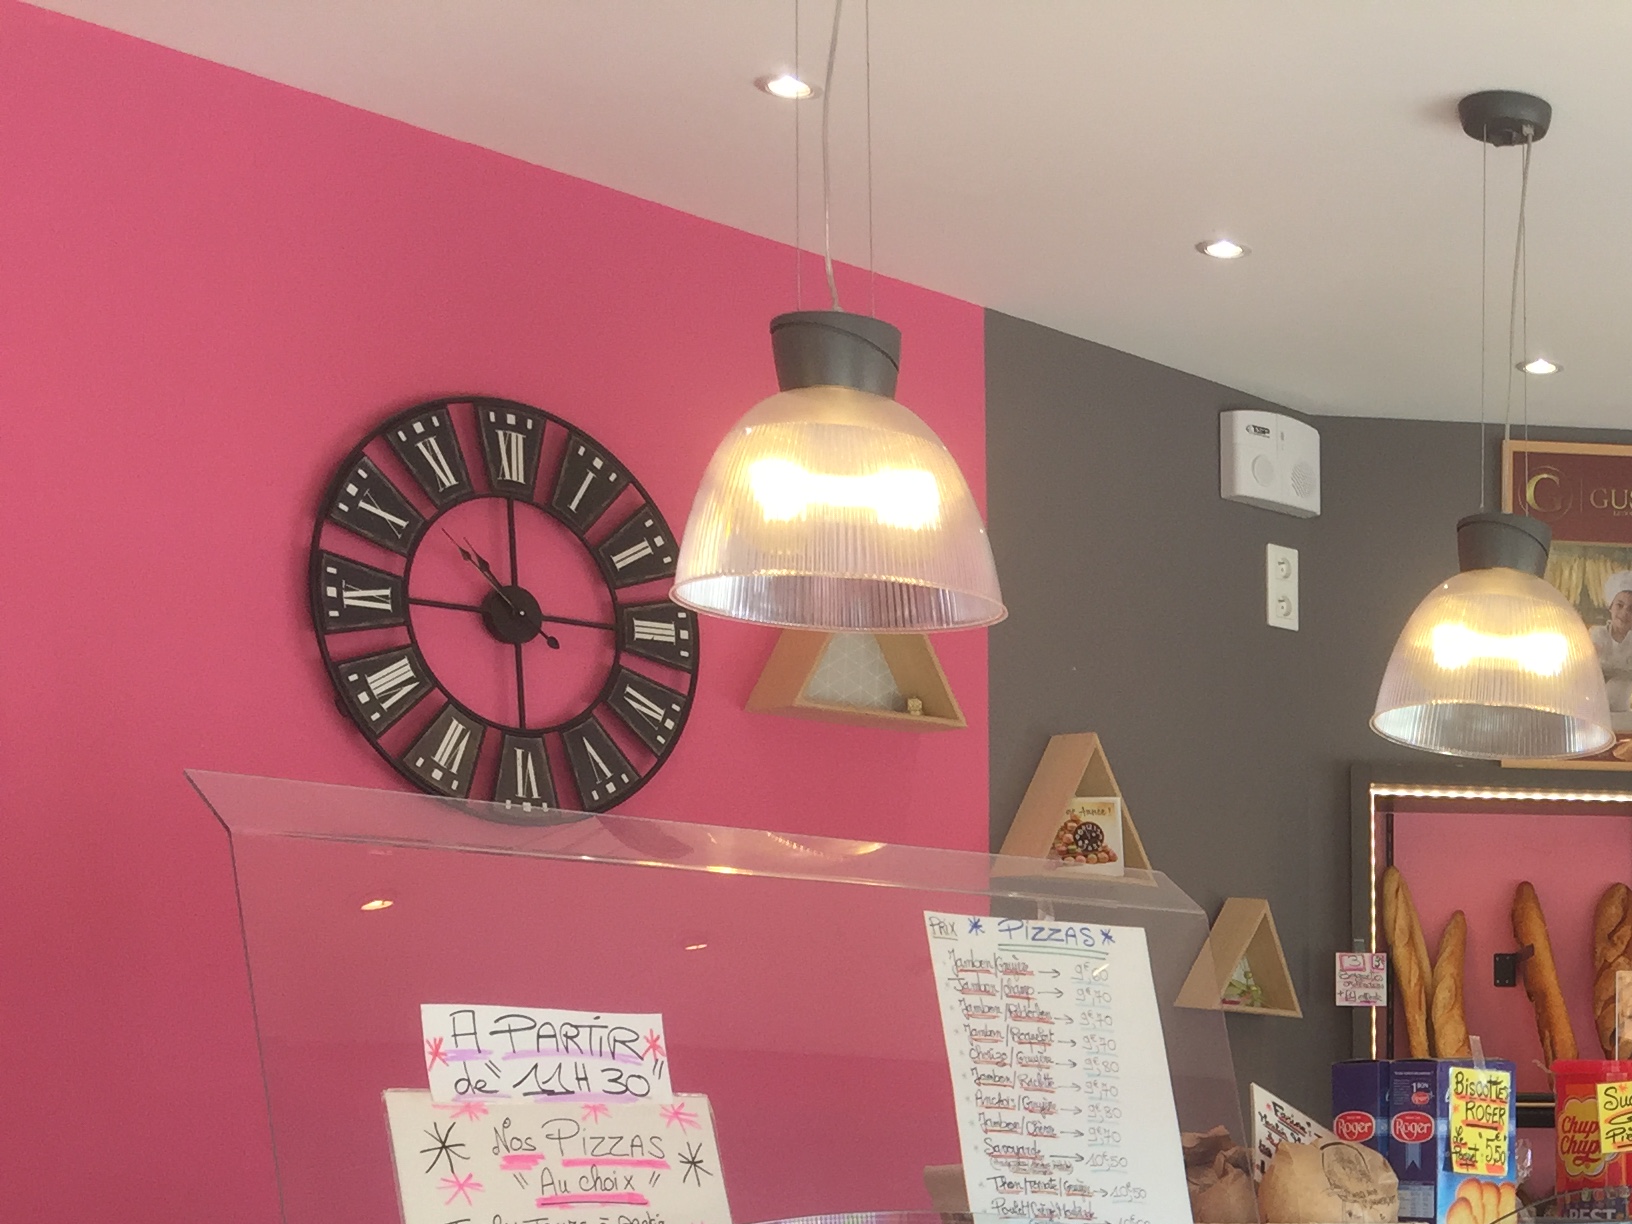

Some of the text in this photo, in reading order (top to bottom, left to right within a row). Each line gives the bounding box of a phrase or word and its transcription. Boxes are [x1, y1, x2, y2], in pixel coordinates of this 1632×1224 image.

[449, 1008, 482, 1054] A
[454, 1061, 499, 1096] de
[1465, 1101, 1506, 1125] ROGER
[1562, 1115, 1599, 1134] Chup
[492, 1117, 538, 1157] Nos
[1338, 1118, 1372, 1141] Roger
[1395, 1118, 1432, 1141] Roger
[1561, 1136, 1601, 1158] Chup
[541, 1165, 634, 1195] Au choix
